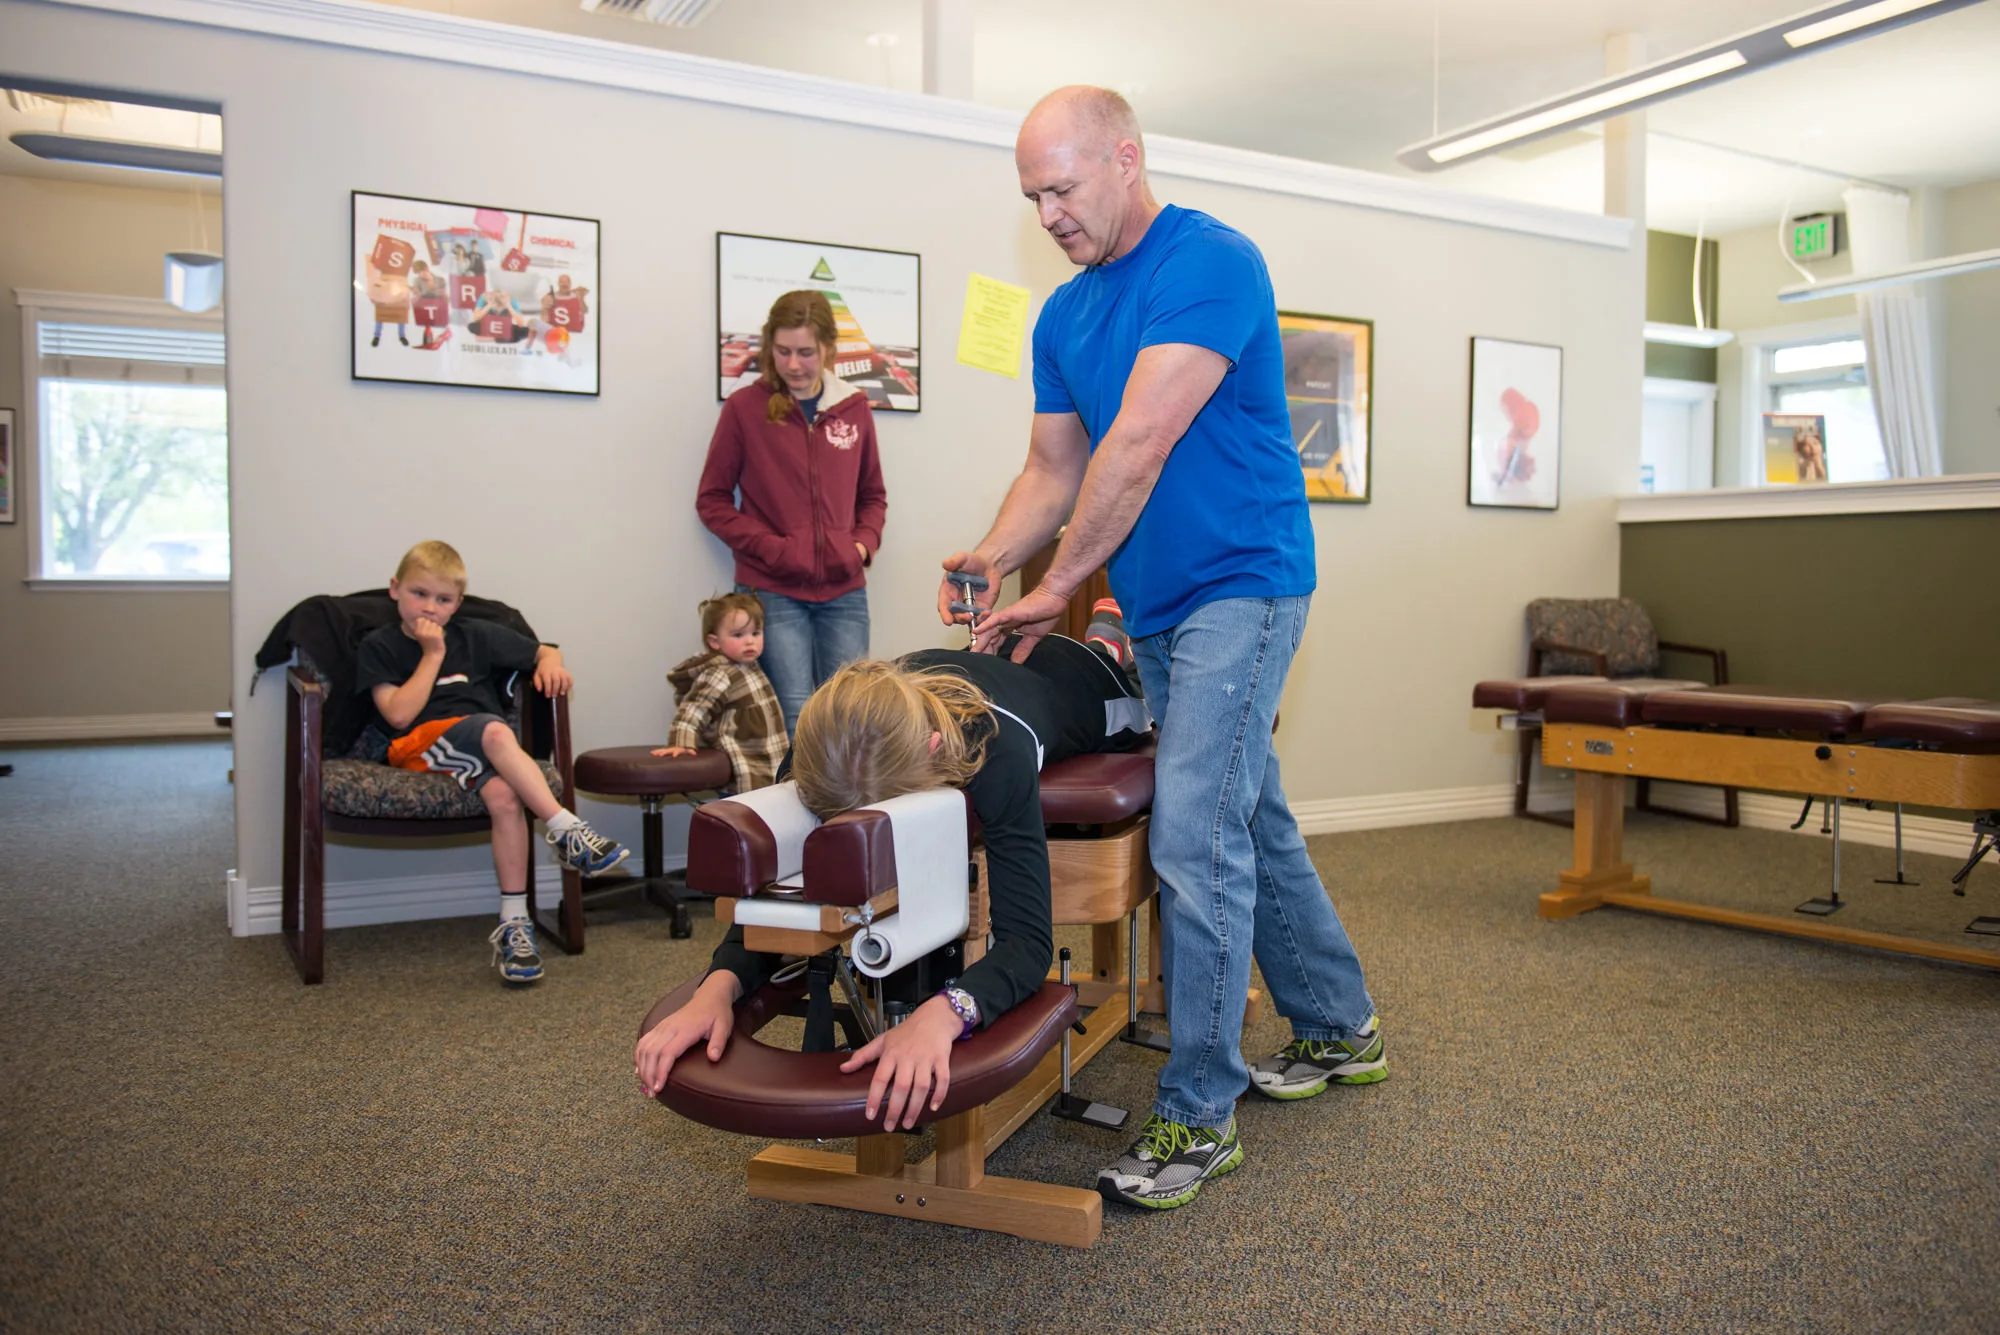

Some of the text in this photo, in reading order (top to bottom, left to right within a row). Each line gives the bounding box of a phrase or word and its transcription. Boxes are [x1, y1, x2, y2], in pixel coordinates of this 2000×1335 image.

[377, 217, 427, 231] PHYSICAL
[530, 235, 575, 249] CHEMICAL
[1795, 222, 1826, 256] EXIT
[388, 251, 404, 268] S
[424, 306, 437, 320] T
[461, 284, 477, 302] R
[490, 321, 503, 334] E
[554, 307, 571, 325] S
[461, 343, 543, 356] SUBLUXATIN
[834, 360, 872, 377] RELIEF
